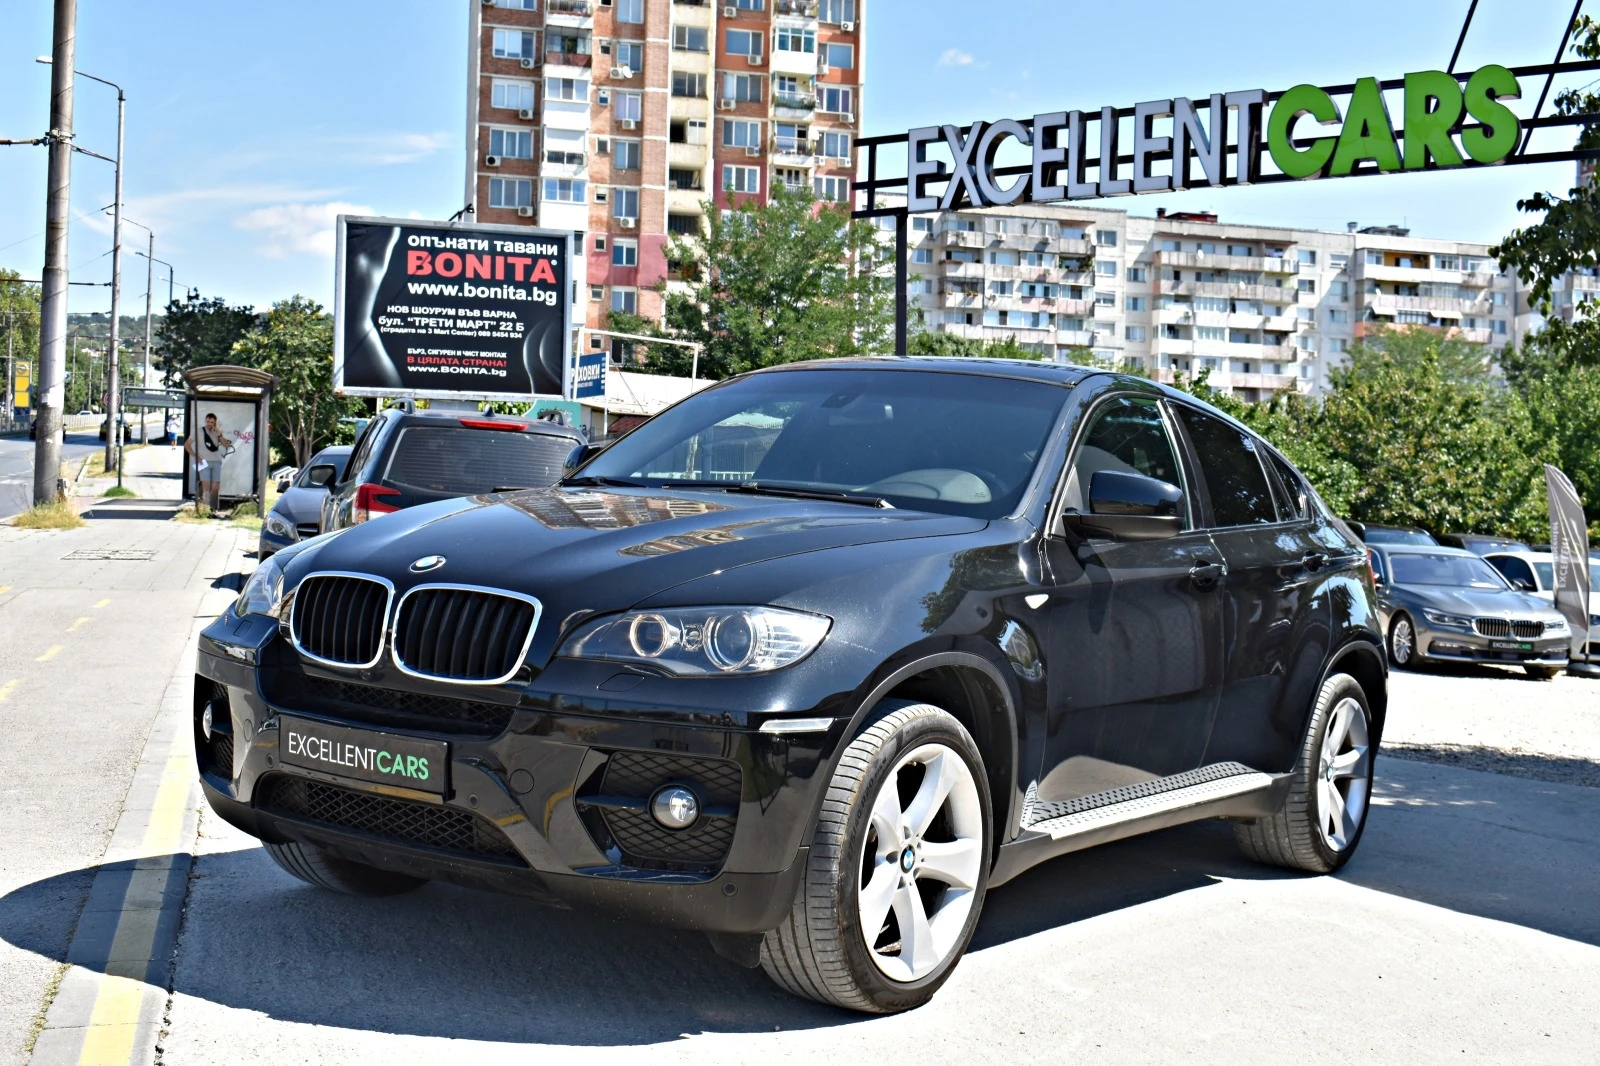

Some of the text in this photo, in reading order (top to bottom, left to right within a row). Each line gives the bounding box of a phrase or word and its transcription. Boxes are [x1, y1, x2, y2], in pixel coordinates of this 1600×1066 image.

[907, 64, 1522, 212] EXCELLENTCARS
[407, 235, 558, 256] опънати тавани
[407, 282, 557, 306] www.bonita.bg
[387, 305, 517, 319] НОВ ШОУРУМ ВЪВ ВАРНА
[378, 316, 404, 327] бул.
[499, 322, 513, 331] 22
[516, 322, 524, 331] Б
[418, 357, 459, 366] ЦЯЛАТА
[462, 358, 507, 367] СТРАНА!
[407, 366, 507, 377] www.BONITA.bg
[288, 731, 429, 780] EXCELLENTCARS
